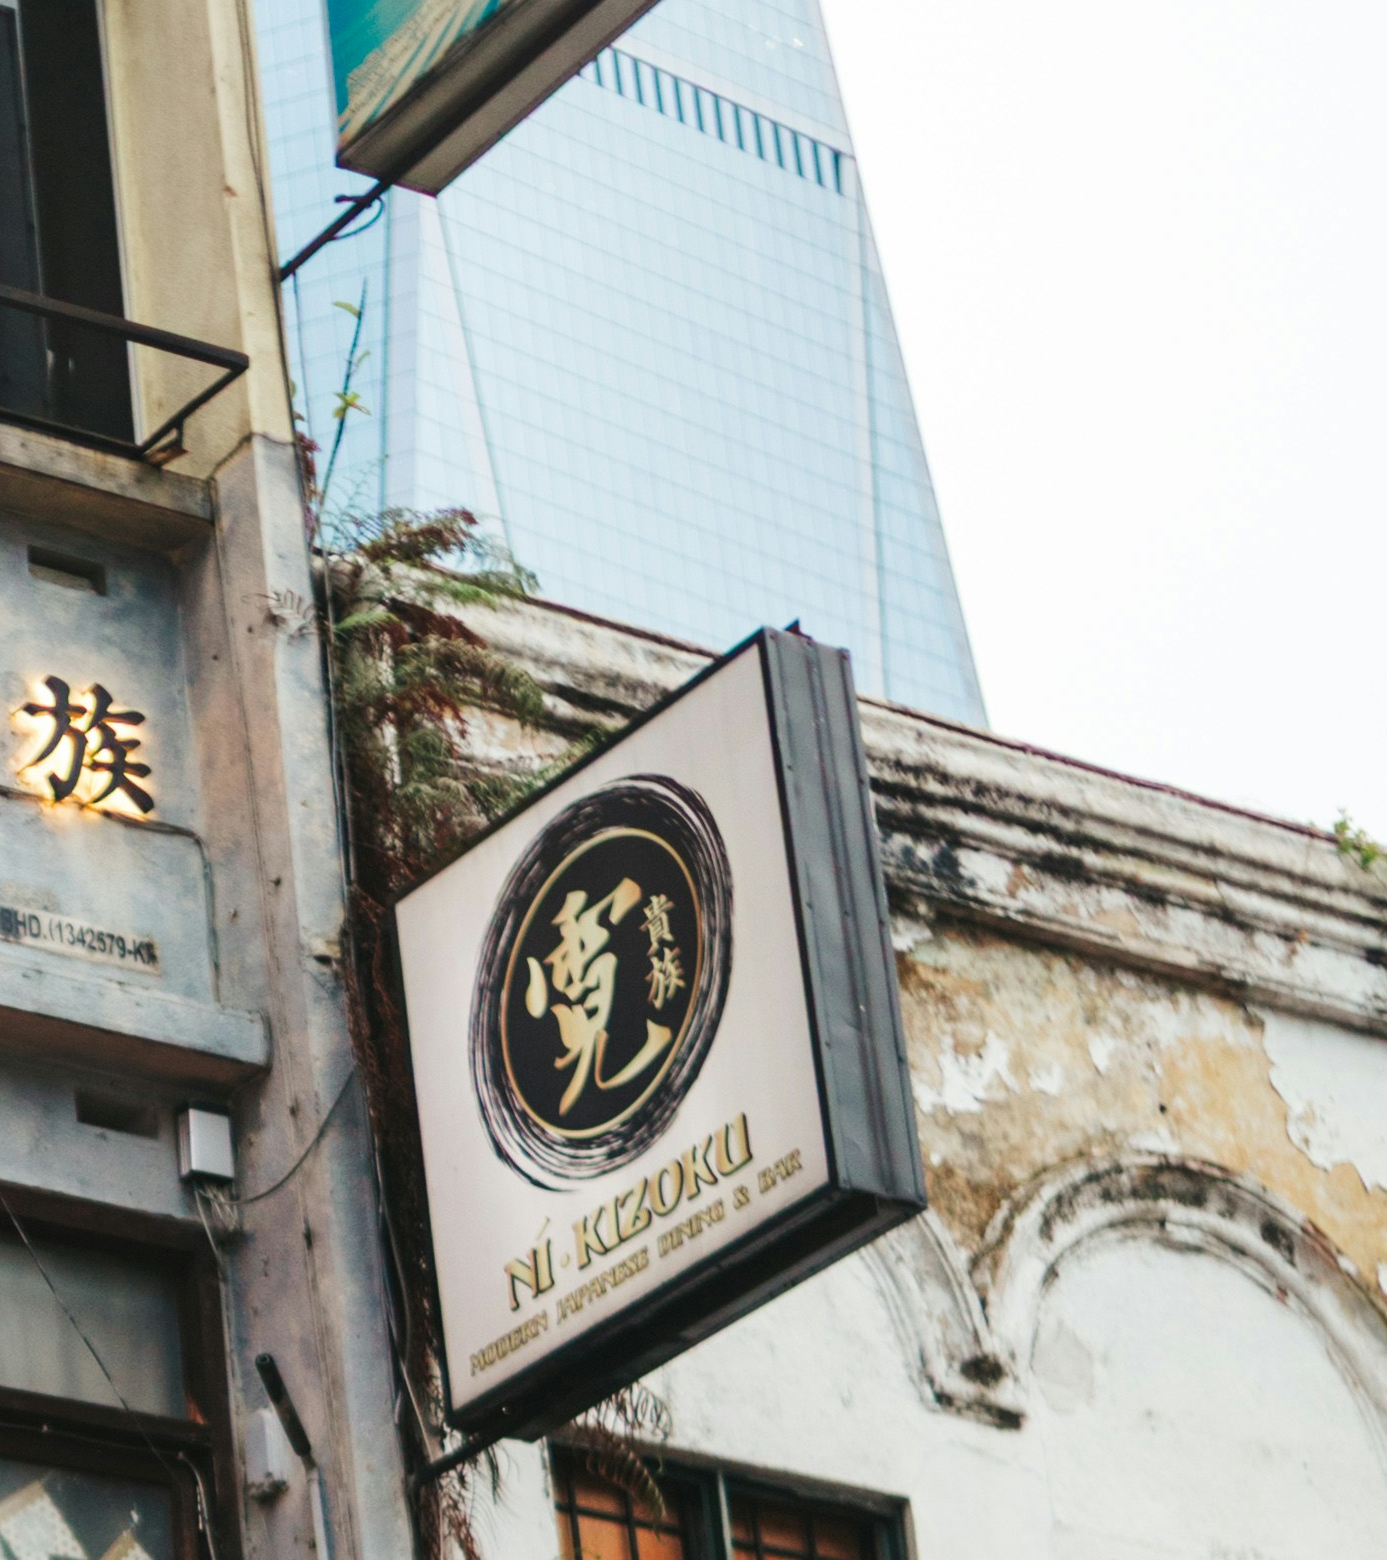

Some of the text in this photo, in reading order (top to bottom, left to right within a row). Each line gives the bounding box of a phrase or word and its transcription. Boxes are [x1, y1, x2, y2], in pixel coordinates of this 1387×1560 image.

[469, 1148, 803, 1377] MODERN JAPANESE DINING & BAR
[571, 1111, 754, 1270] KIZOKU
